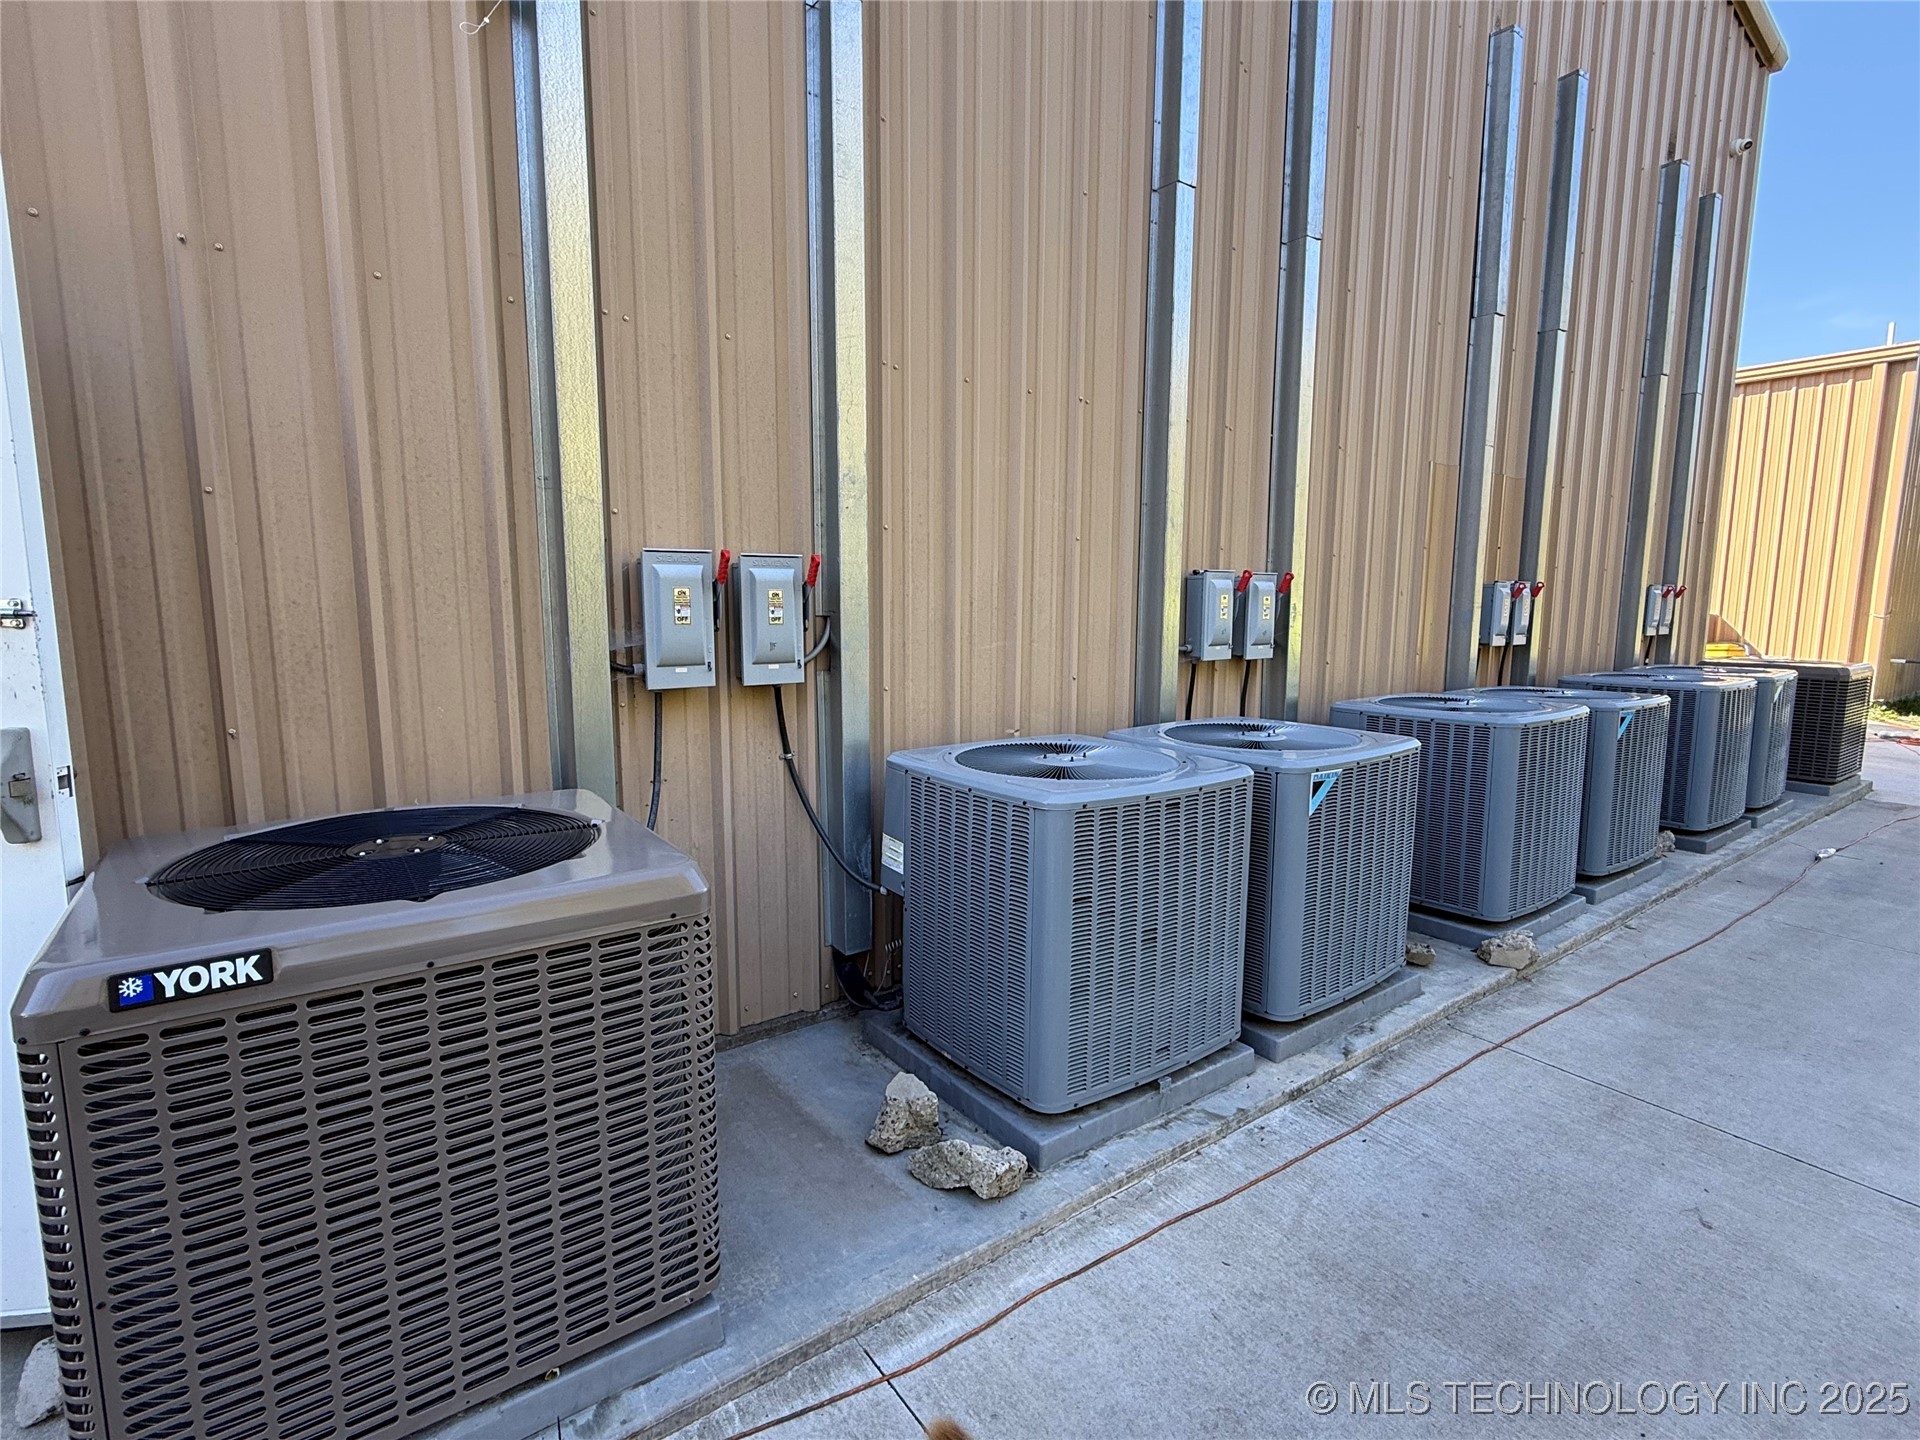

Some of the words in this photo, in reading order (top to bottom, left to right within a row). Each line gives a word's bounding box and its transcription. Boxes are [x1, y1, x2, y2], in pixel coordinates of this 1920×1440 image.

[656, 554, 700, 563] SIEMENS
[1313, 771, 1340, 780] DAIKIN
[153, 954, 263, 998] YORK
